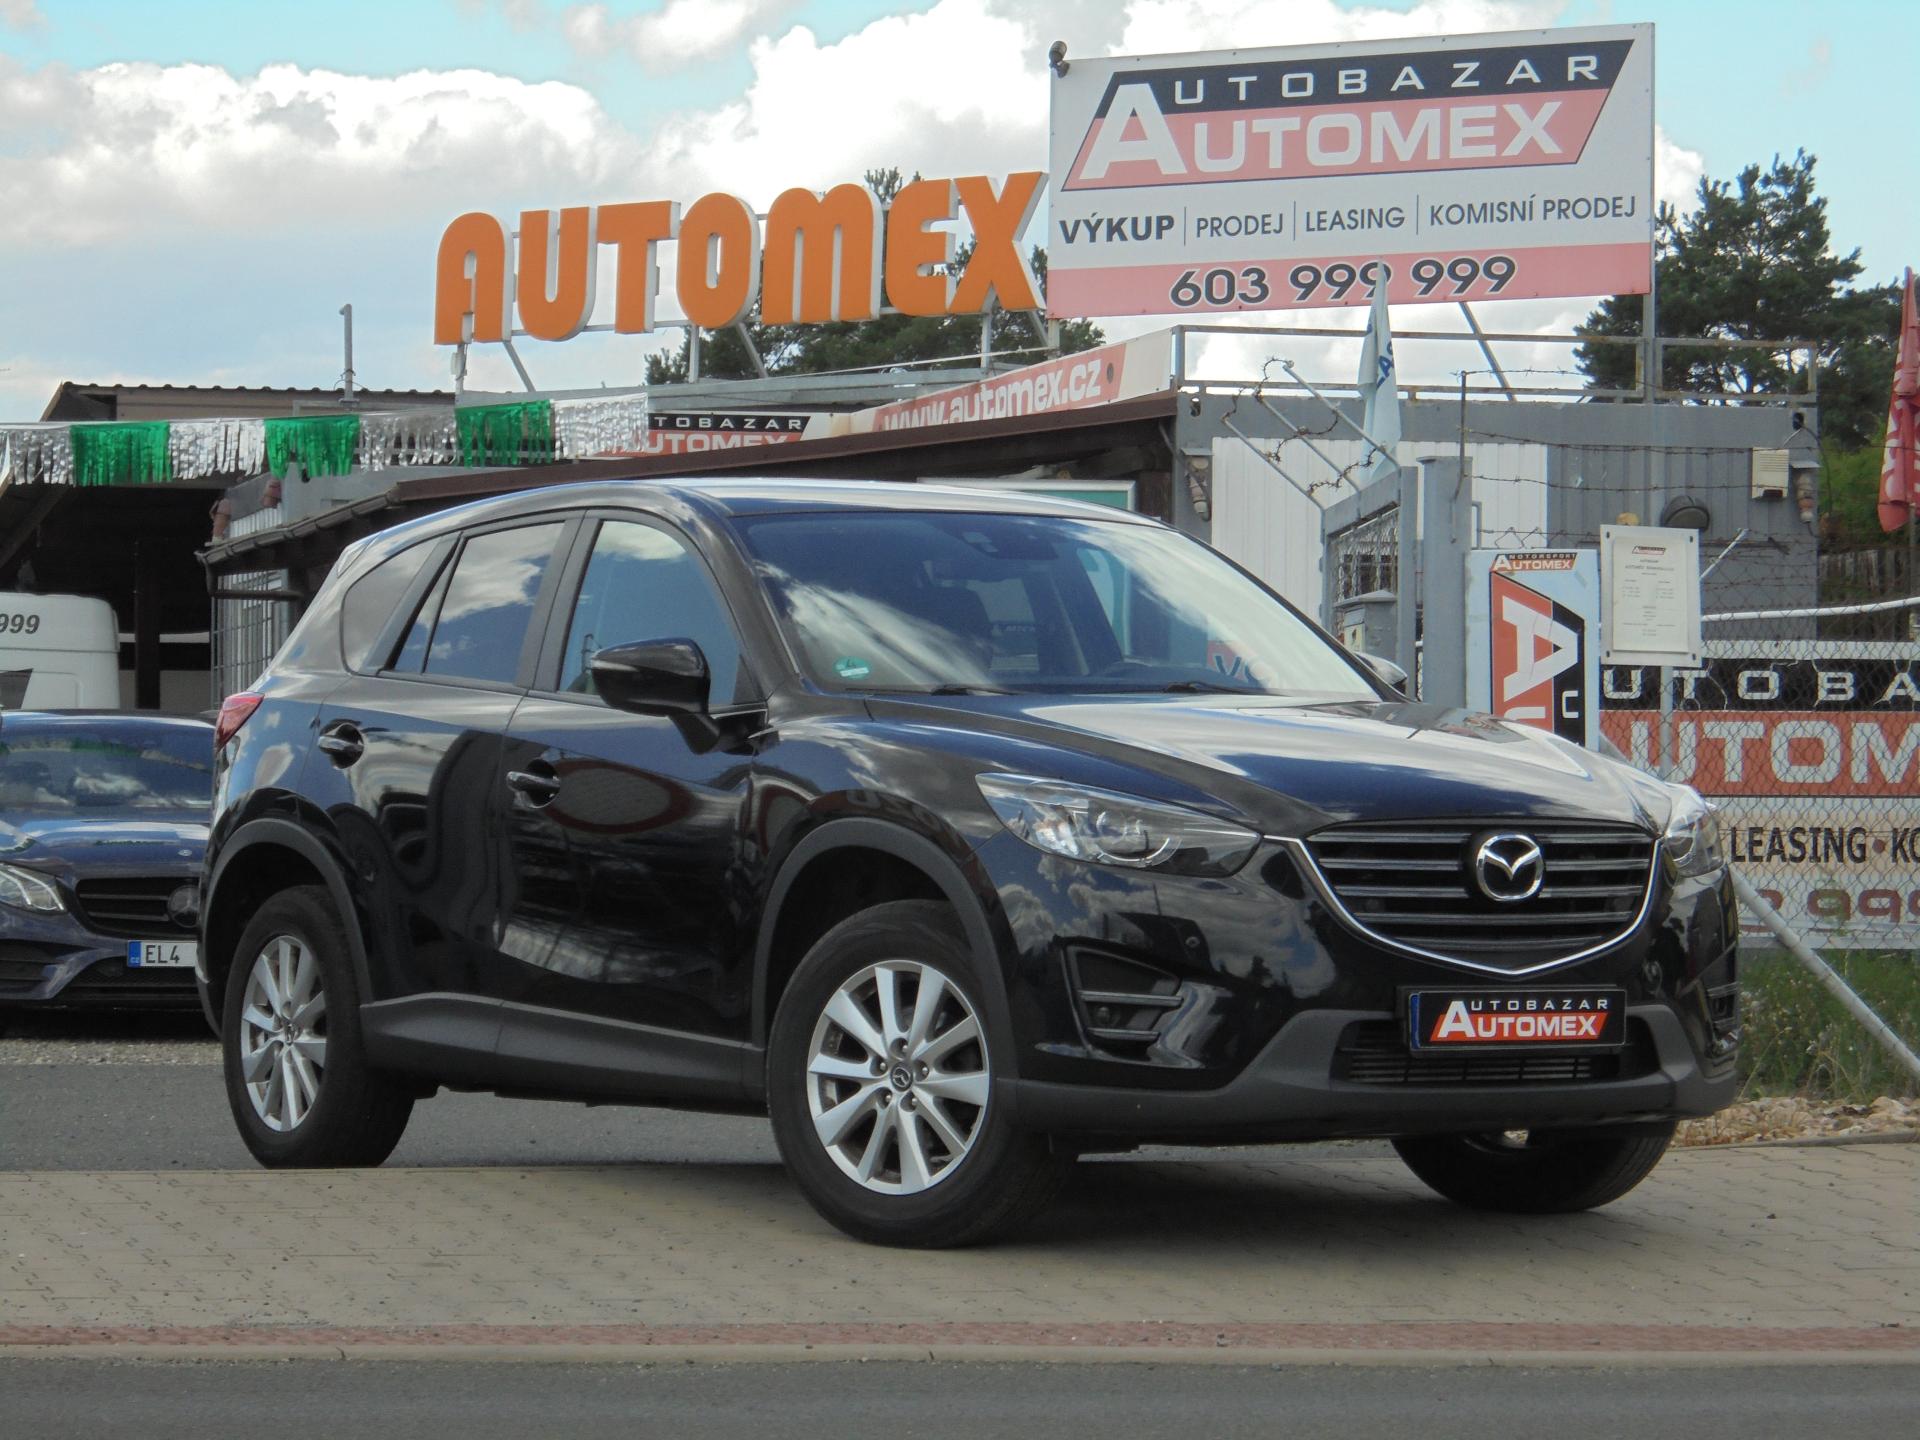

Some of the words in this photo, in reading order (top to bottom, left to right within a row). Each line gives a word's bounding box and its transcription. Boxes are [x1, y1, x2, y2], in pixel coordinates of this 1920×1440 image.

[1060, 211, 1176, 245] VÝKUP
[1196, 214, 1285, 239] PRODEJ
[1305, 206, 1406, 233] LEASING
[1429, 194, 1536, 227] KOMISNÍ
[1543, 195, 1637, 221] PRODEJ
[434, 171, 1050, 345] AUTOMEX
[1169, 266, 1270, 307] 603
[1289, 261, 1392, 302] 999
[1411, 255, 1517, 297] 999
[1731, 827, 1867, 864] LEASING
